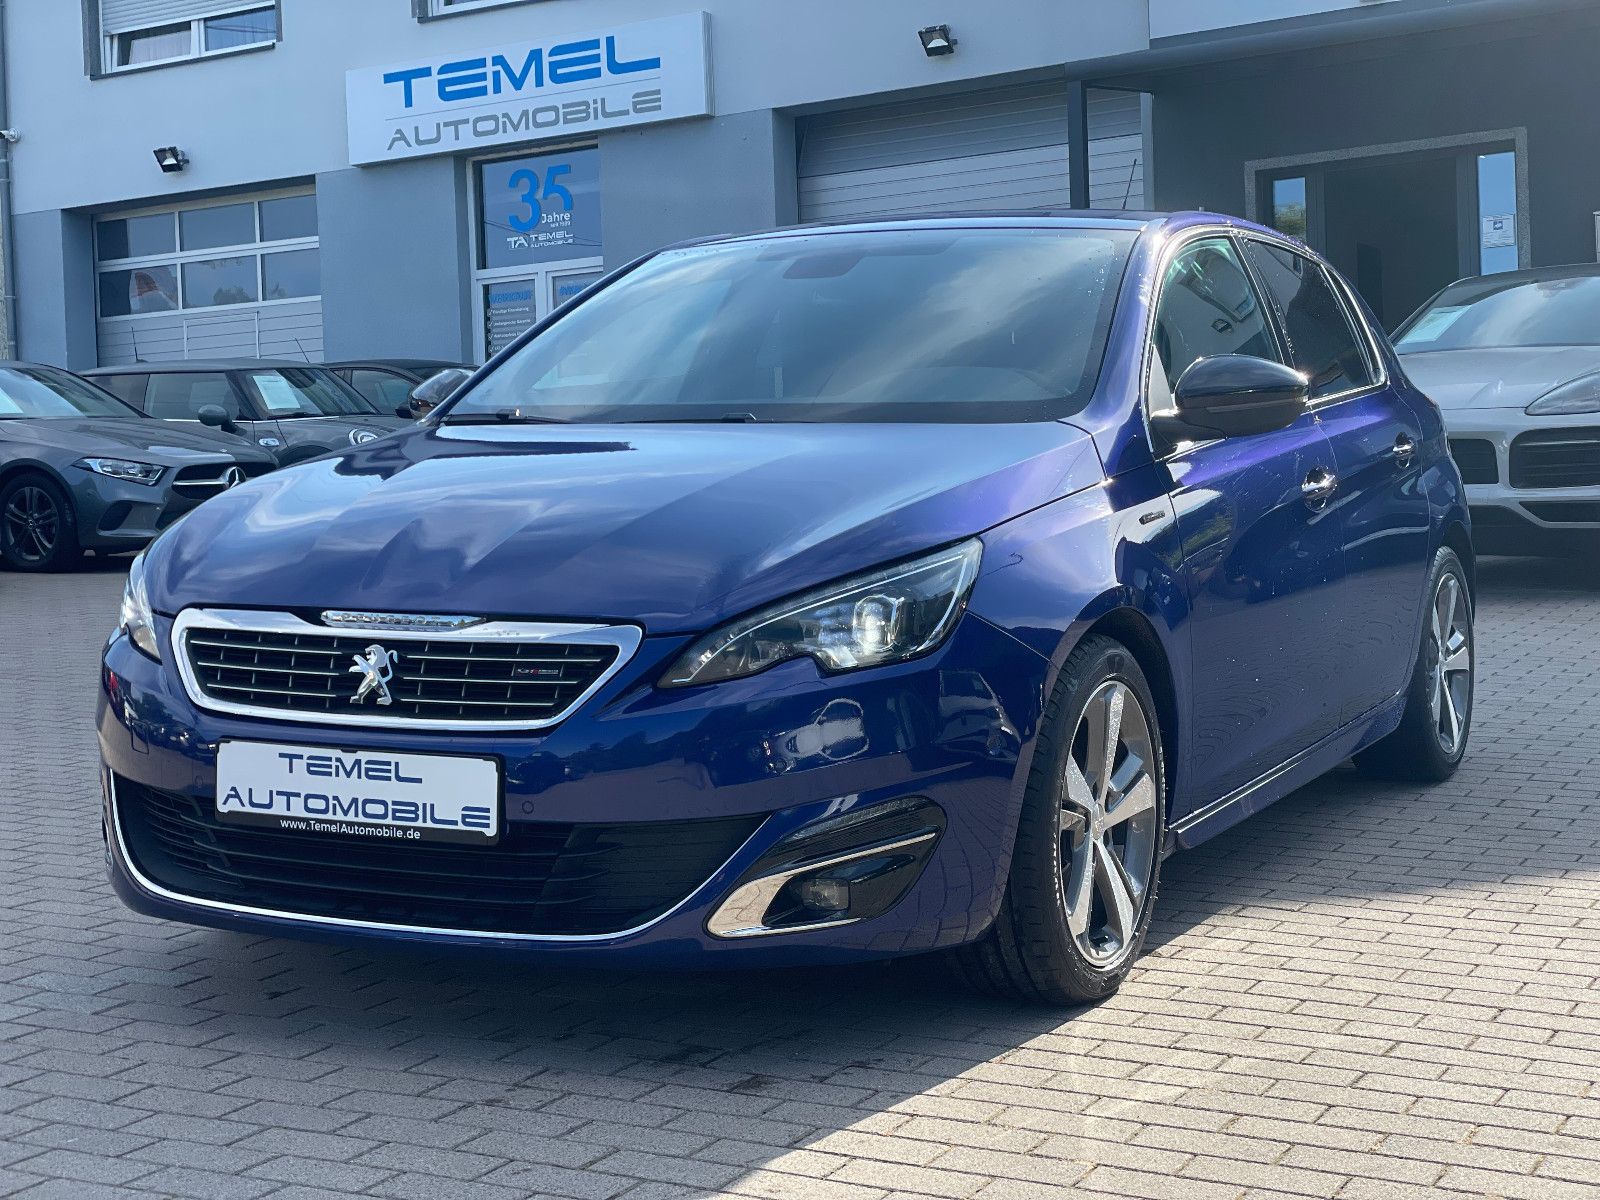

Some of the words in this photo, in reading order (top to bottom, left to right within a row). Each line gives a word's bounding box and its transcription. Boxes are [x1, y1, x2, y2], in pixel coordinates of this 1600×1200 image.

[383, 36, 661, 108] TEMEL
[508, 164, 573, 233] 35
[541, 212, 571, 224] Jahre
[507, 236, 528, 249] TA
[530, 231, 573, 241] TEMEL
[278, 752, 423, 784] TEMEL
[222, 785, 491, 829] AUTOMOBILE
[279, 818, 421, 840] www.TemelAutomobile.de
